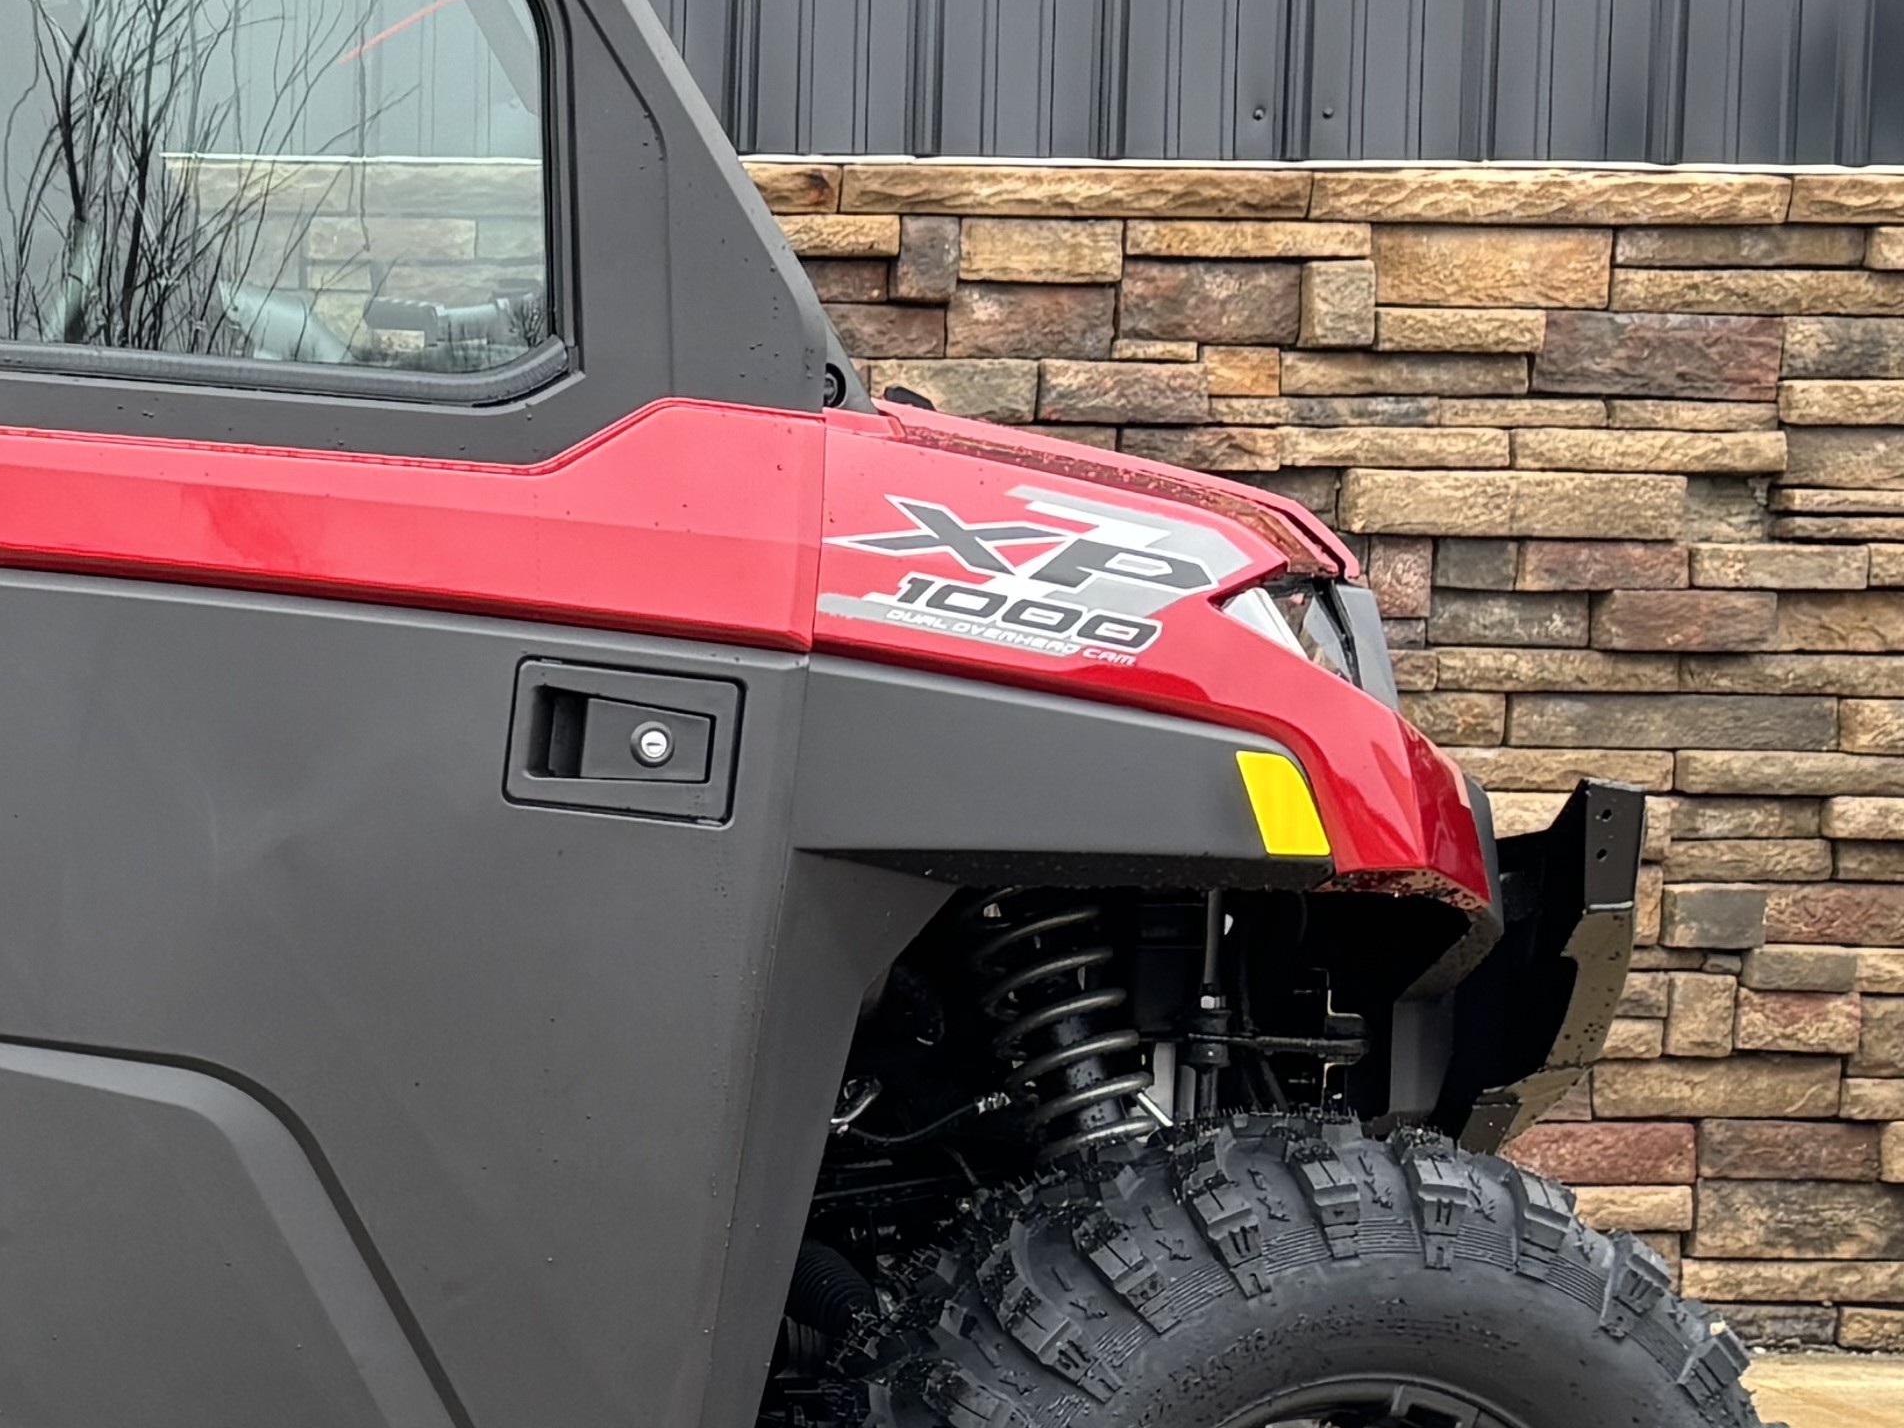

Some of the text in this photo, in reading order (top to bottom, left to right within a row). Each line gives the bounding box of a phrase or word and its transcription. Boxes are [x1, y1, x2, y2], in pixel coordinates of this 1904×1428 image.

[824, 494, 1218, 593] XP
[886, 609, 1138, 667] DUAL OVERHEAD CAM
[896, 574, 1162, 650] 1000
